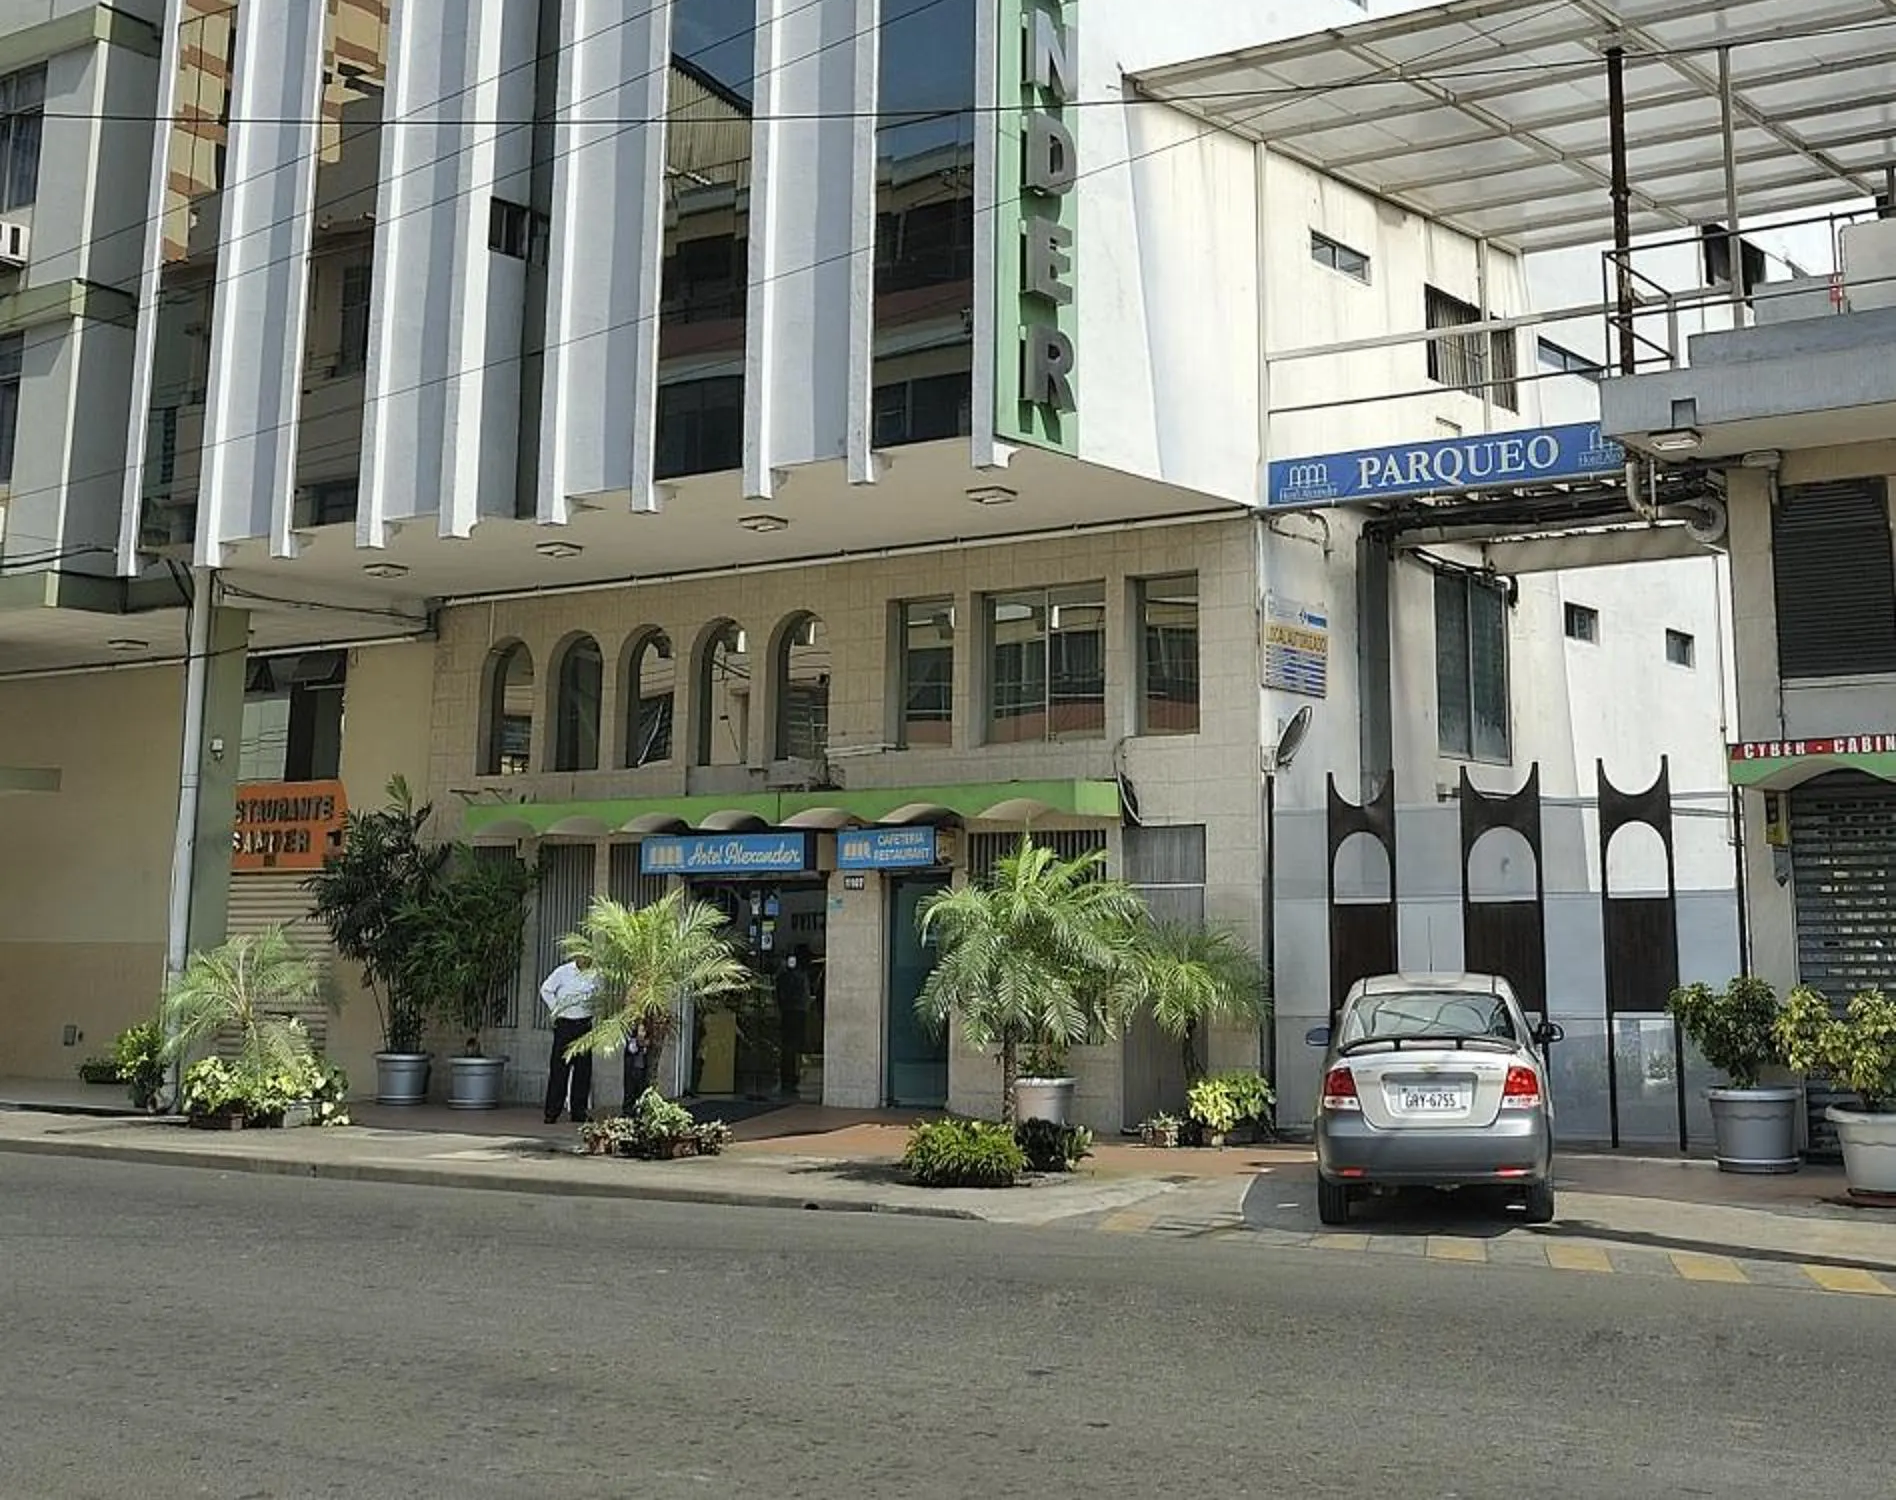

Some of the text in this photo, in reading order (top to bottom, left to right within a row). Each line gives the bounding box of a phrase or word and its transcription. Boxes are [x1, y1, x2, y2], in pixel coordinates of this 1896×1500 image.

[1357, 435, 1559, 489] PARQUEO
[1743, 741, 1806, 759] CYBER
[687, 840, 800, 866] Hotel Alexander
